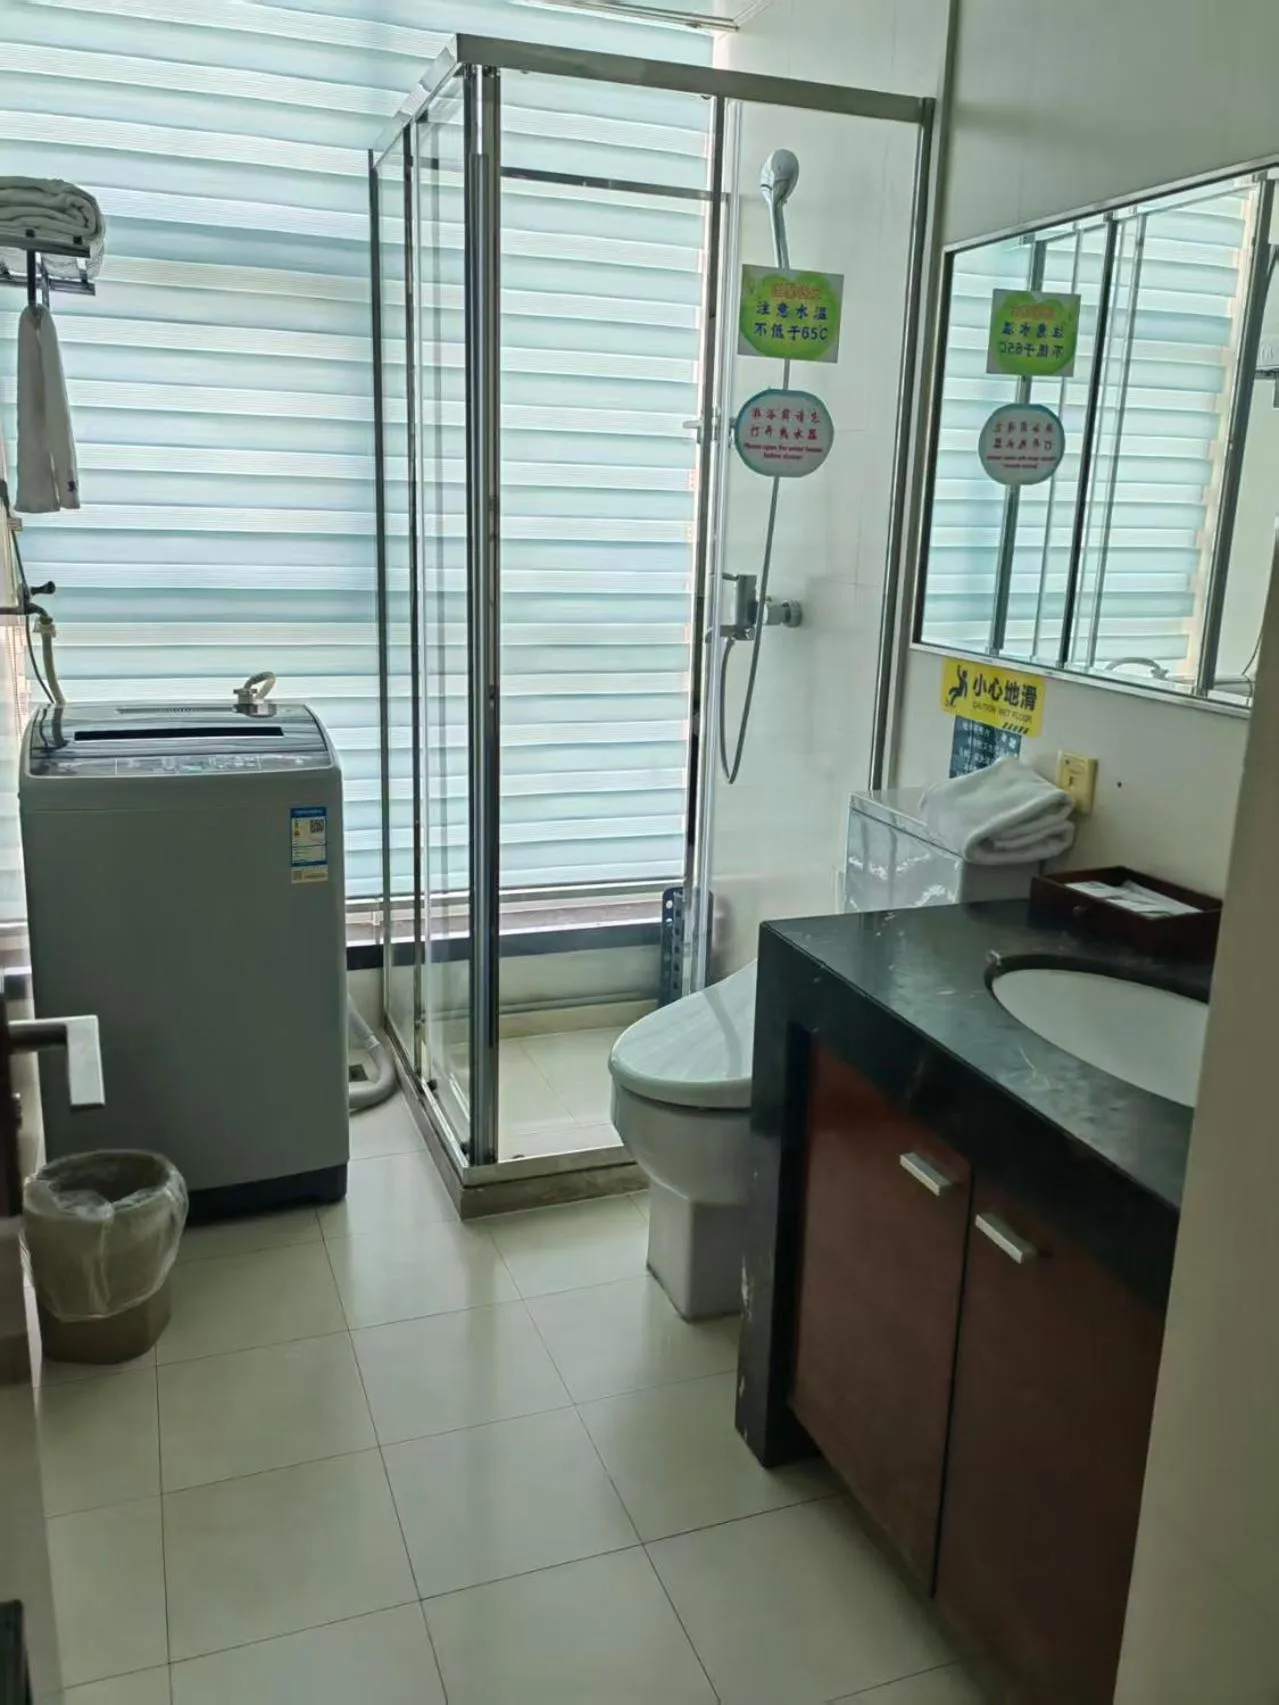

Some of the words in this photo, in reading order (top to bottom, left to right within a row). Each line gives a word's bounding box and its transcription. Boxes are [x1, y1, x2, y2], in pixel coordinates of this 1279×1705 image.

[756, 300, 829, 321] 注意水温
[973, 673, 1037, 711] 小心地滑
